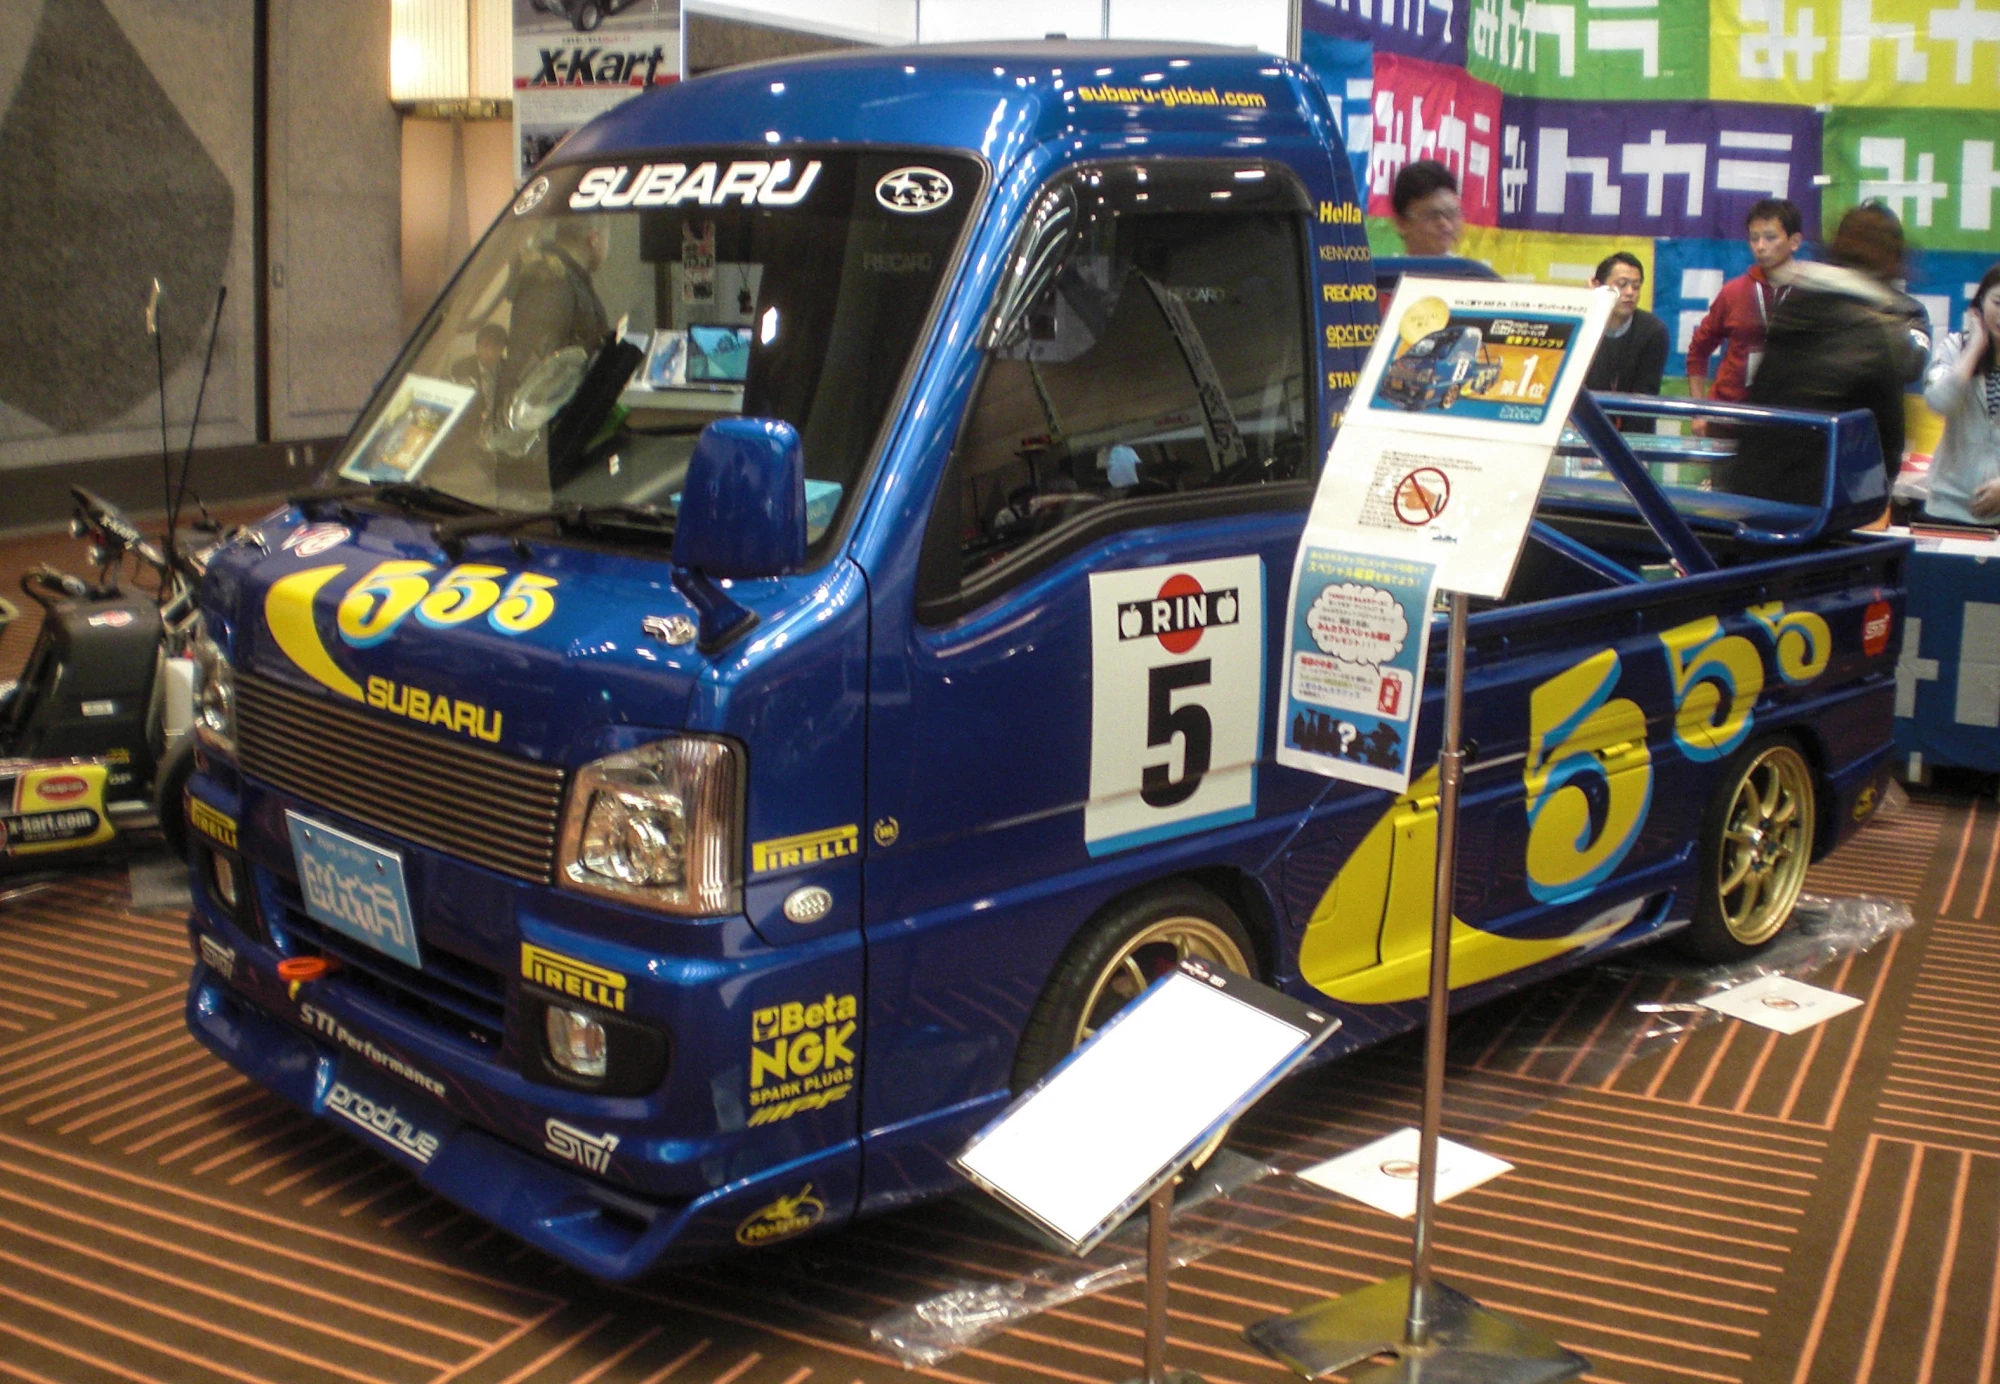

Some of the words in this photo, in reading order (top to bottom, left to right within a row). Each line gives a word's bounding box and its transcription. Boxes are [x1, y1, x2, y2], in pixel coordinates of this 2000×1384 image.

[528, 46, 664, 90] X-Kart
[1077, 83, 1267, 107] subaru-global.com
[569, 160, 822, 210] SUBARU
[1502, 125, 1792, 216] みんカラ
[1319, 201, 1362, 224] Hella
[1319, 245, 1371, 261] KENWOOD
[1323, 284, 1377, 302] RECARO
[337, 560, 559, 648] 555
[1151, 593, 1208, 636] RIN
[367, 675, 502, 743] SUBARU
[1140, 657, 1213, 809] 5
[1523, 601, 1832, 905] 555
[191, 796, 238, 849] PIRELLI
[752, 824, 859, 873] PIRELLI
[520, 941, 628, 1012] PIRELLI
[781, 993, 858, 1034] Beta
[301, 1003, 337, 1036] STI
[337, 1028, 447, 1098] Performance
[751, 1021, 858, 1089] NGK
[749, 1081, 801, 1107] SPARK
[803, 1066, 854, 1095] PLUGS
[326, 1082, 440, 1160] prodrive
